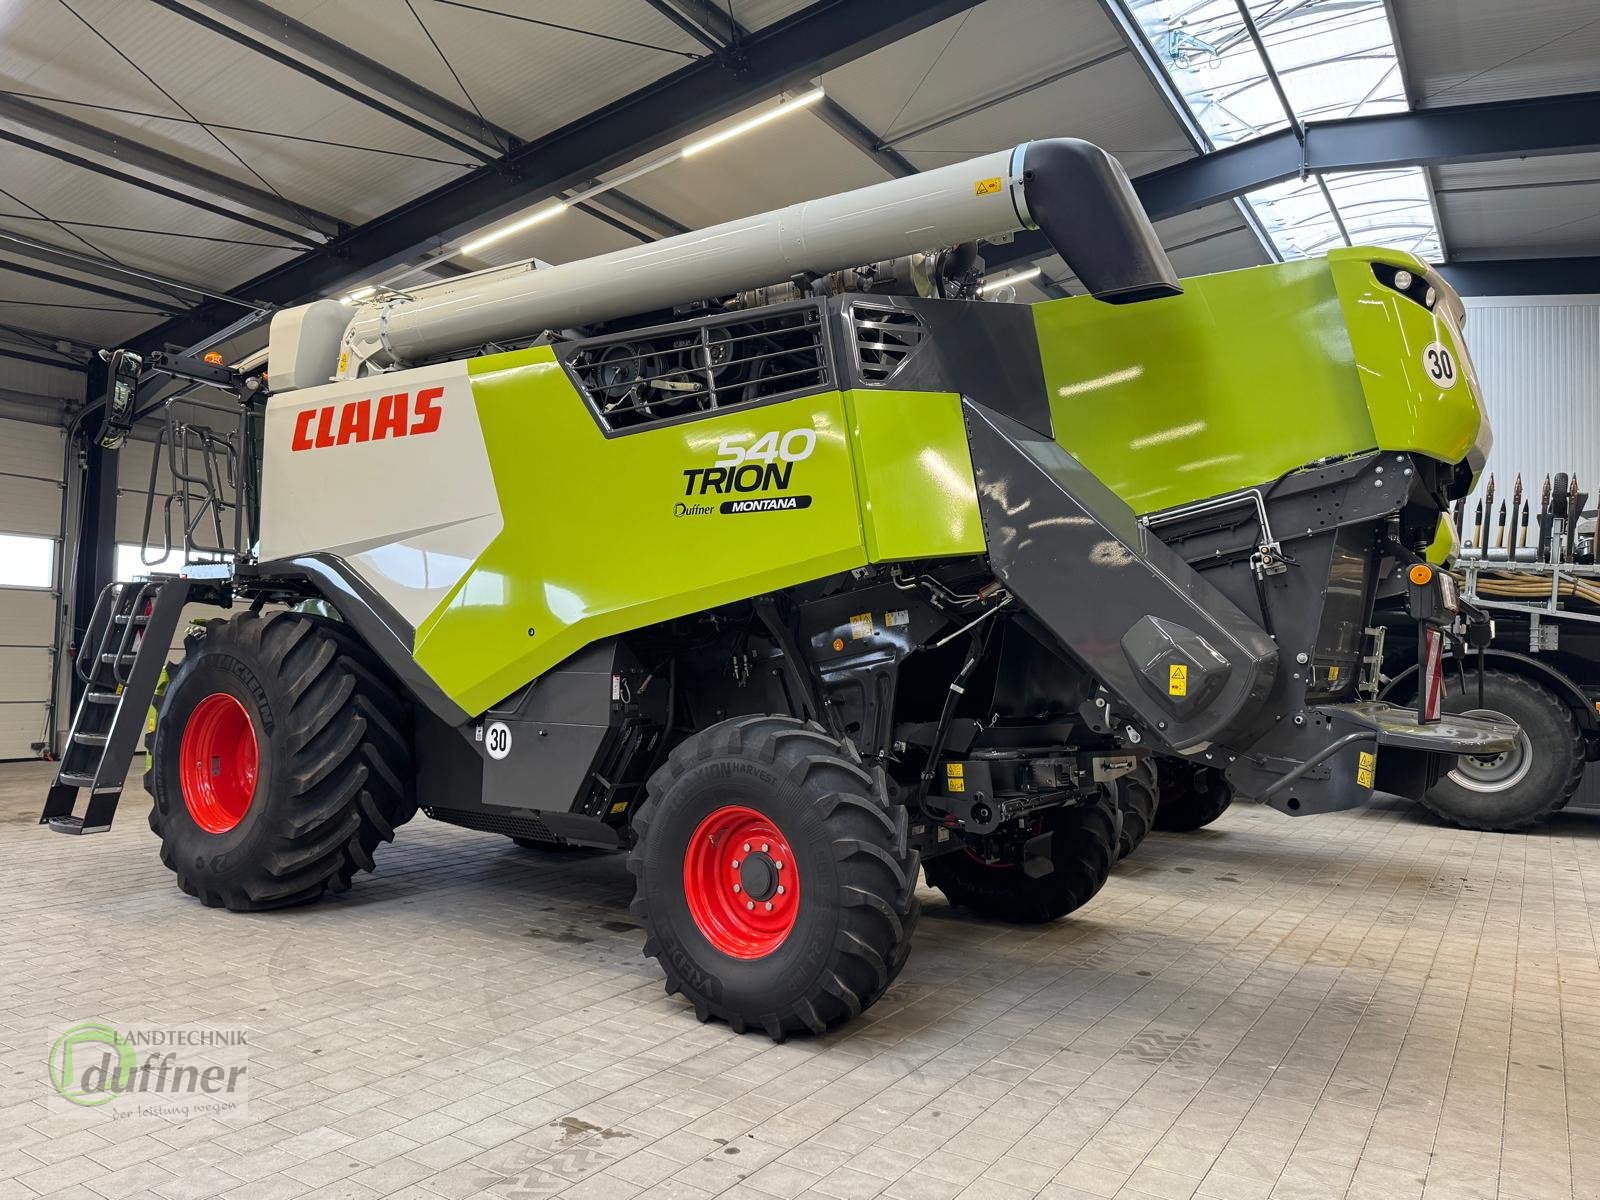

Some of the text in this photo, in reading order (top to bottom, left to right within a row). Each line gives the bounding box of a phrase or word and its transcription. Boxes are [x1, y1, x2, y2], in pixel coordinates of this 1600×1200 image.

[1428, 350, 1452, 379] 30
[292, 387, 444, 451] CLAAS
[715, 428, 817, 468] 540
[683, 461, 793, 495] TRION
[731, 497, 797, 512] MONTANA
[214, 654, 275, 727] MICHELIN
[490, 728, 507, 752] 30
[732, 761, 778, 788] HARVEST
